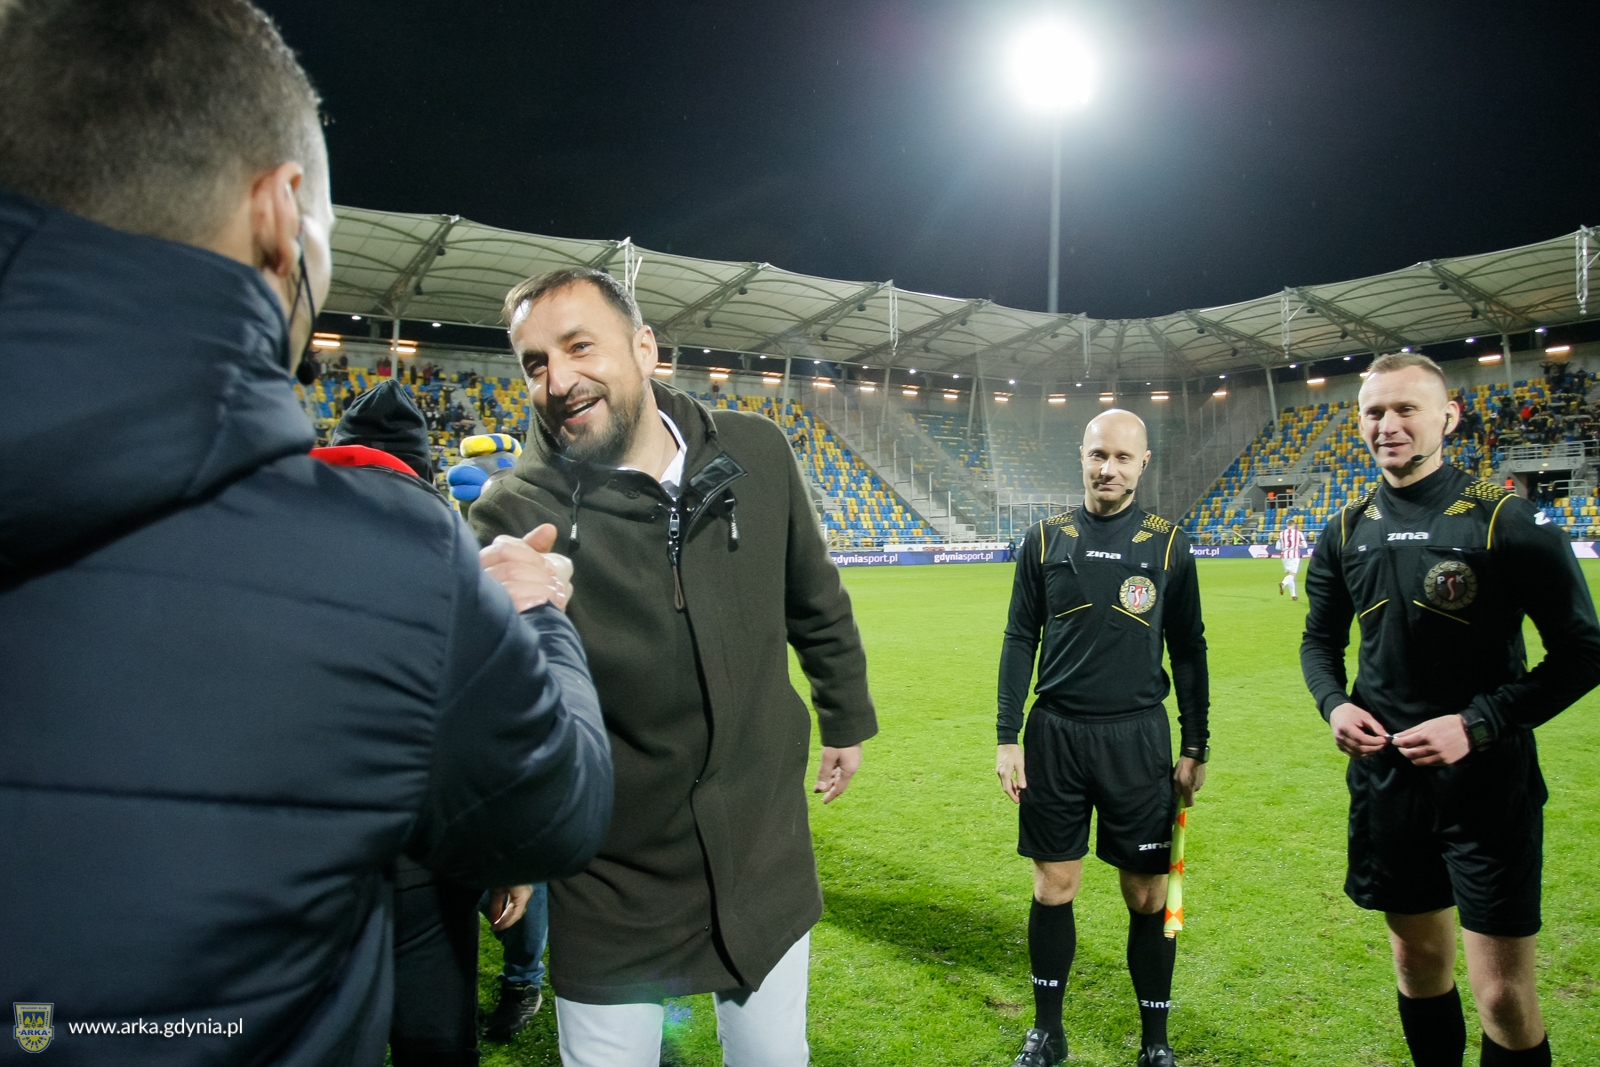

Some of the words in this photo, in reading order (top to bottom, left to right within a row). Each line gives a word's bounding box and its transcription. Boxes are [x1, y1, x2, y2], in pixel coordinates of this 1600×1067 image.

[1387, 531, 1430, 542] zina
[933, 552, 994, 563] gdyniasport.pl
[1085, 550, 1122, 560] zina
